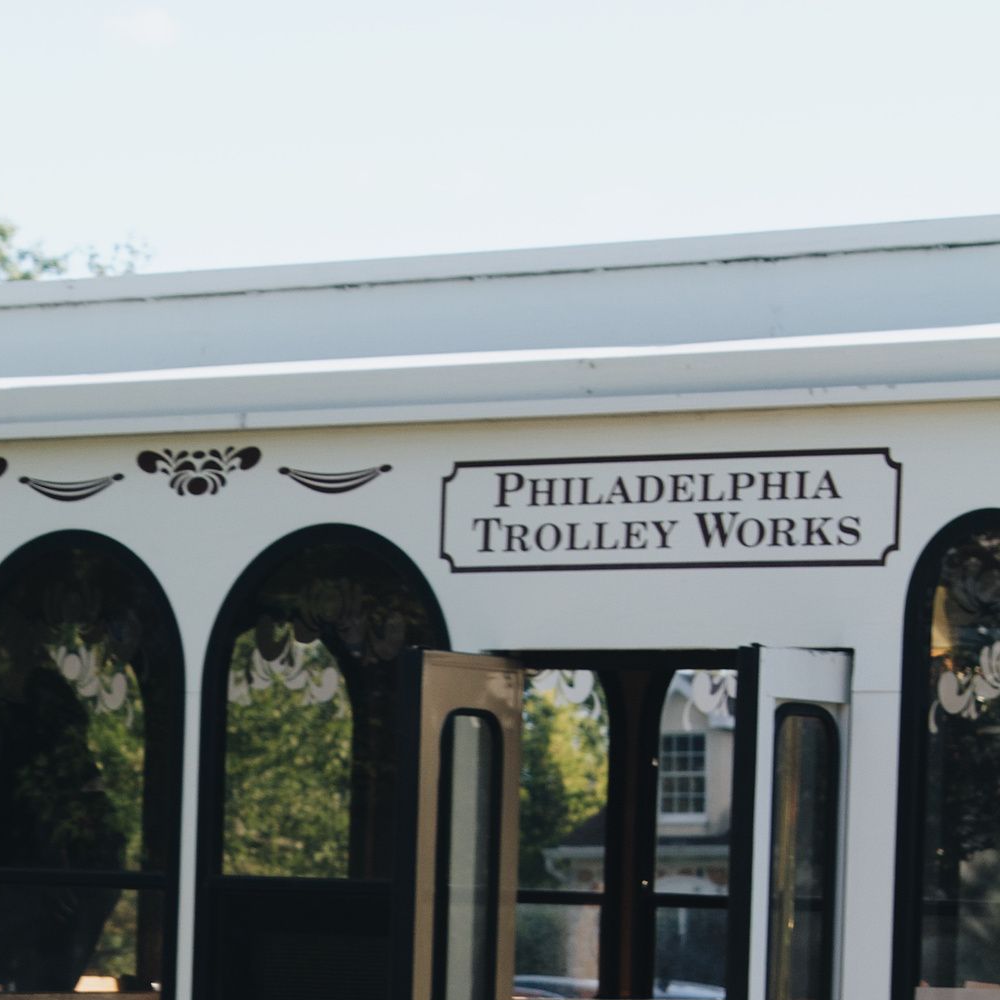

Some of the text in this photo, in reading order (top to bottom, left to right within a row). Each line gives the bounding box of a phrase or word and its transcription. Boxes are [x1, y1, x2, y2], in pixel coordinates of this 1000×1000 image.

[493, 469, 843, 508] PHILADELPHIA
[472, 511, 863, 553] TROLLEY WORKS
